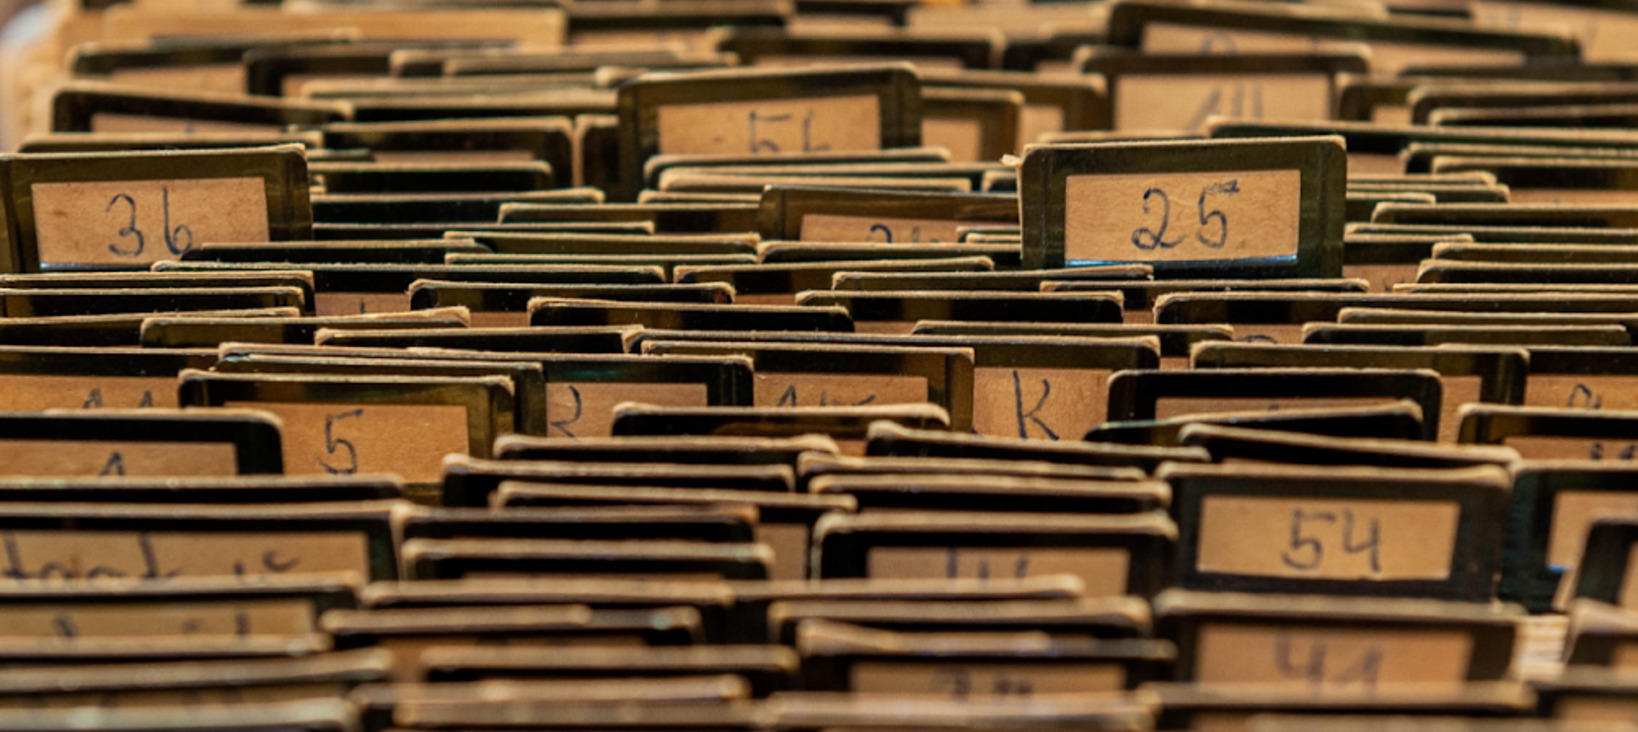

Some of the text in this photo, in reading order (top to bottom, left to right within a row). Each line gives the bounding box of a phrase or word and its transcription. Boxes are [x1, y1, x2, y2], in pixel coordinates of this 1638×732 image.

[105, 187, 193, 256] 36
[1131, 179, 1240, 251] 25
[315, 408, 364, 475] 5
[1281, 508, 1382, 573] 54
